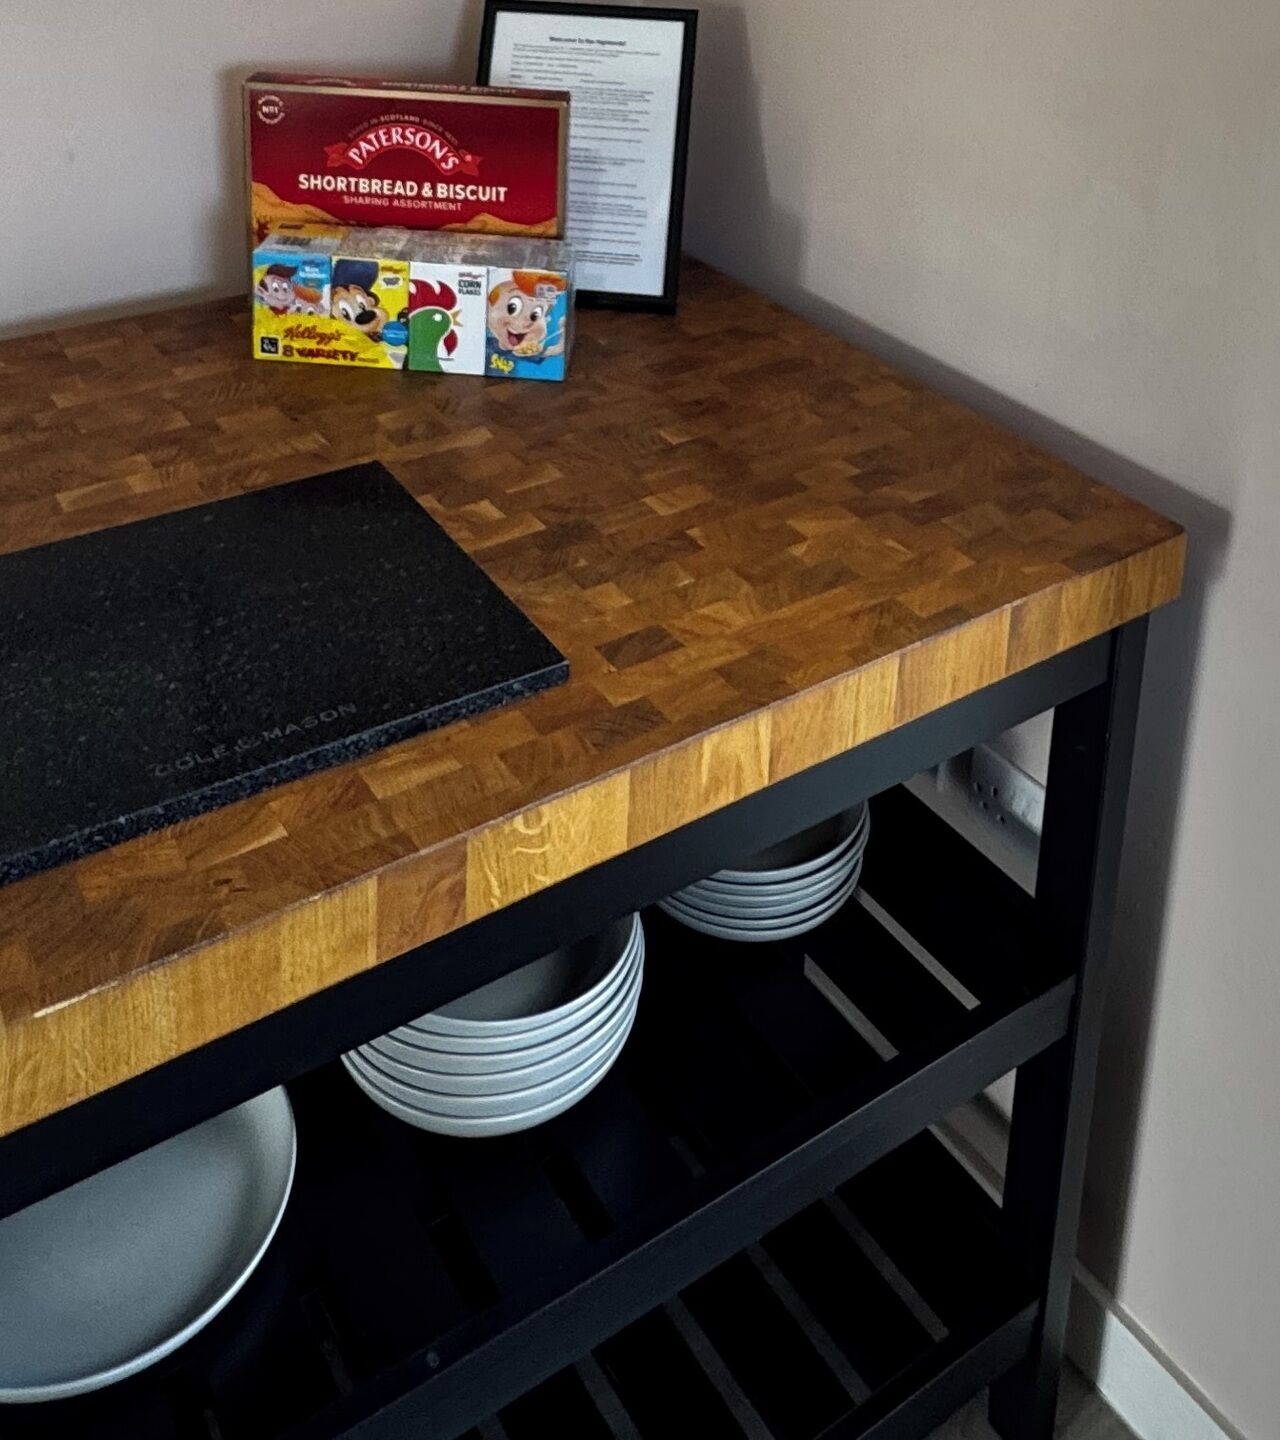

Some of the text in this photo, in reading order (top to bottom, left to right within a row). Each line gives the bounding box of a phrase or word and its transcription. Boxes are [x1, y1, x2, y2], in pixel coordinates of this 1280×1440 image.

[380, 113, 420, 123] SCOTLAND
[347, 126, 461, 171] PATERSON'S
[298, 173, 508, 202] SHORTBREAD & BISCUIT
[343, 195, 462, 211] SHARING ASSORTMENT
[458, 279, 482, 289] CORN
[282, 345, 294, 357] 8
[295, 347, 360, 361] VARIETY
[153, 743, 233, 777] COLE
[261, 702, 359, 742] MASON
